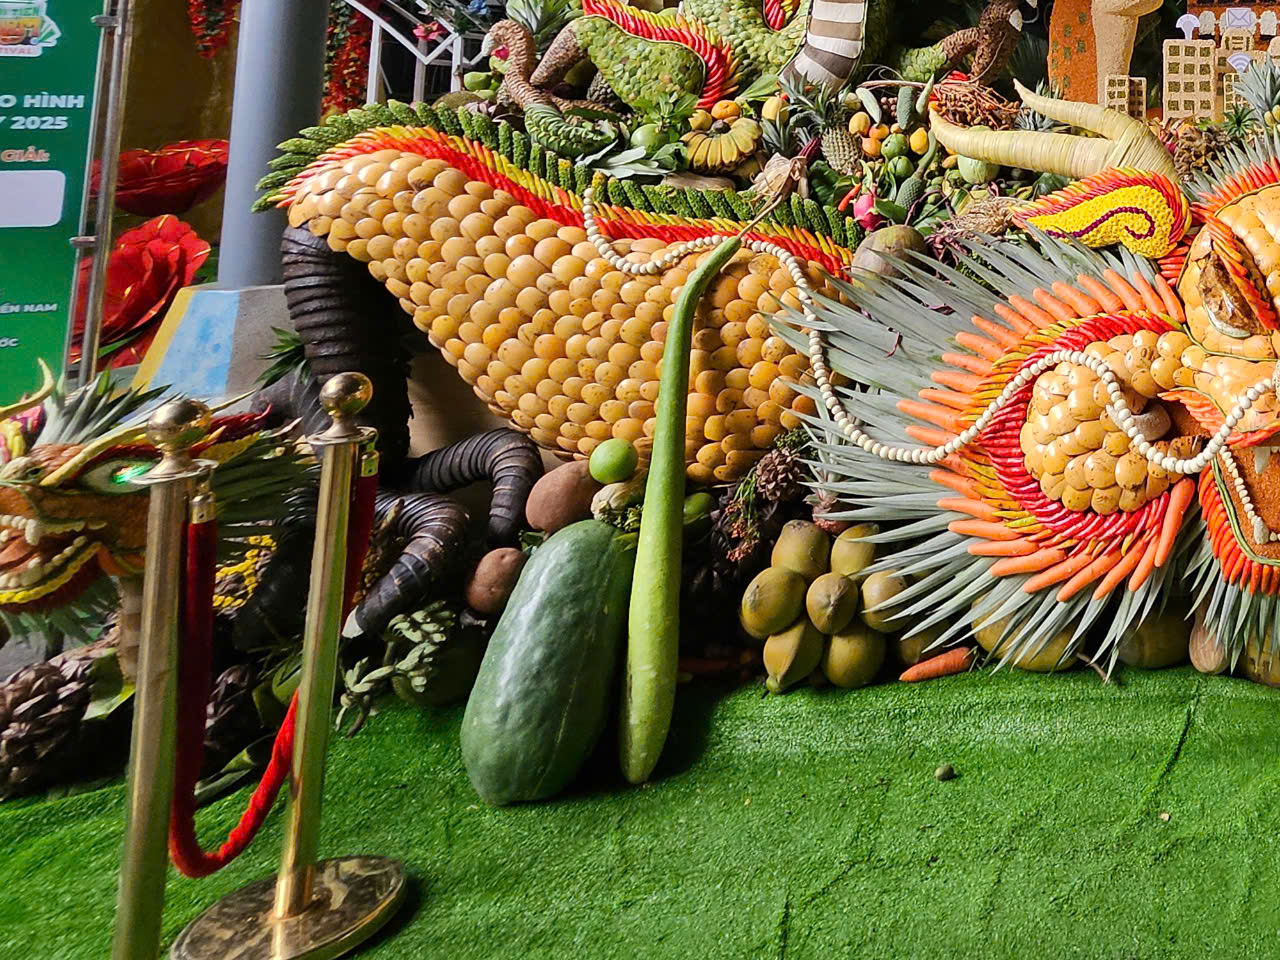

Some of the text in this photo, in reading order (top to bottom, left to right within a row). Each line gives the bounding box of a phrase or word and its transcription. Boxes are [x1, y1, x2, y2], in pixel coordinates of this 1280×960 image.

[24, 91, 85, 108] HÌNH
[10, 115, 68, 130] 2025
[23, 303, 58, 313] NAM
